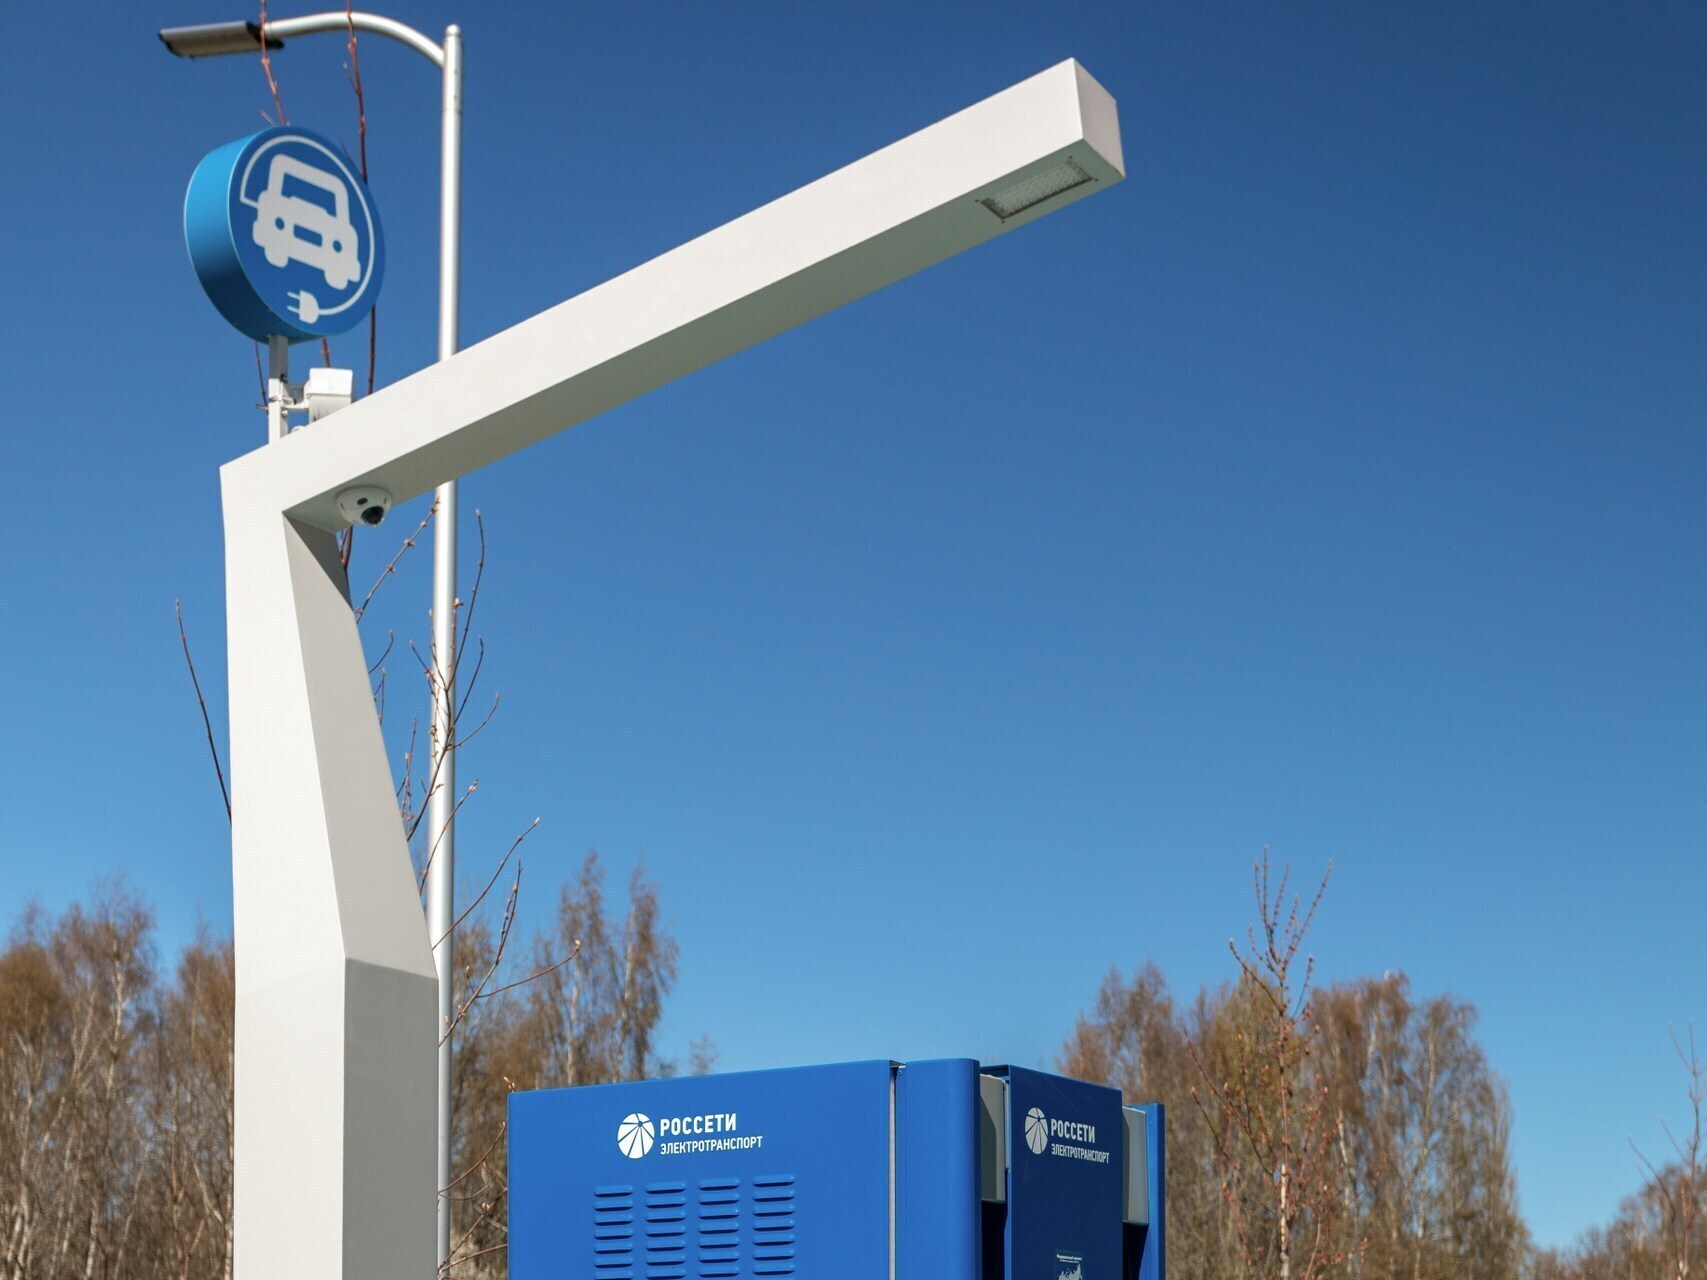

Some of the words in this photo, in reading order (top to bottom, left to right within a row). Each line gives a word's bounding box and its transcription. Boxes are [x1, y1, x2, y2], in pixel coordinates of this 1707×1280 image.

[660, 1113, 737, 1137] РОССЕТИ
[1050, 1118, 1095, 1143] РОССЕТИ
[660, 1136, 763, 1155] ЭЛЕКТРОТРАНСПОРТ
[1051, 1143, 1110, 1164] ЭЛЕКТРОТРАНСПОРТ
